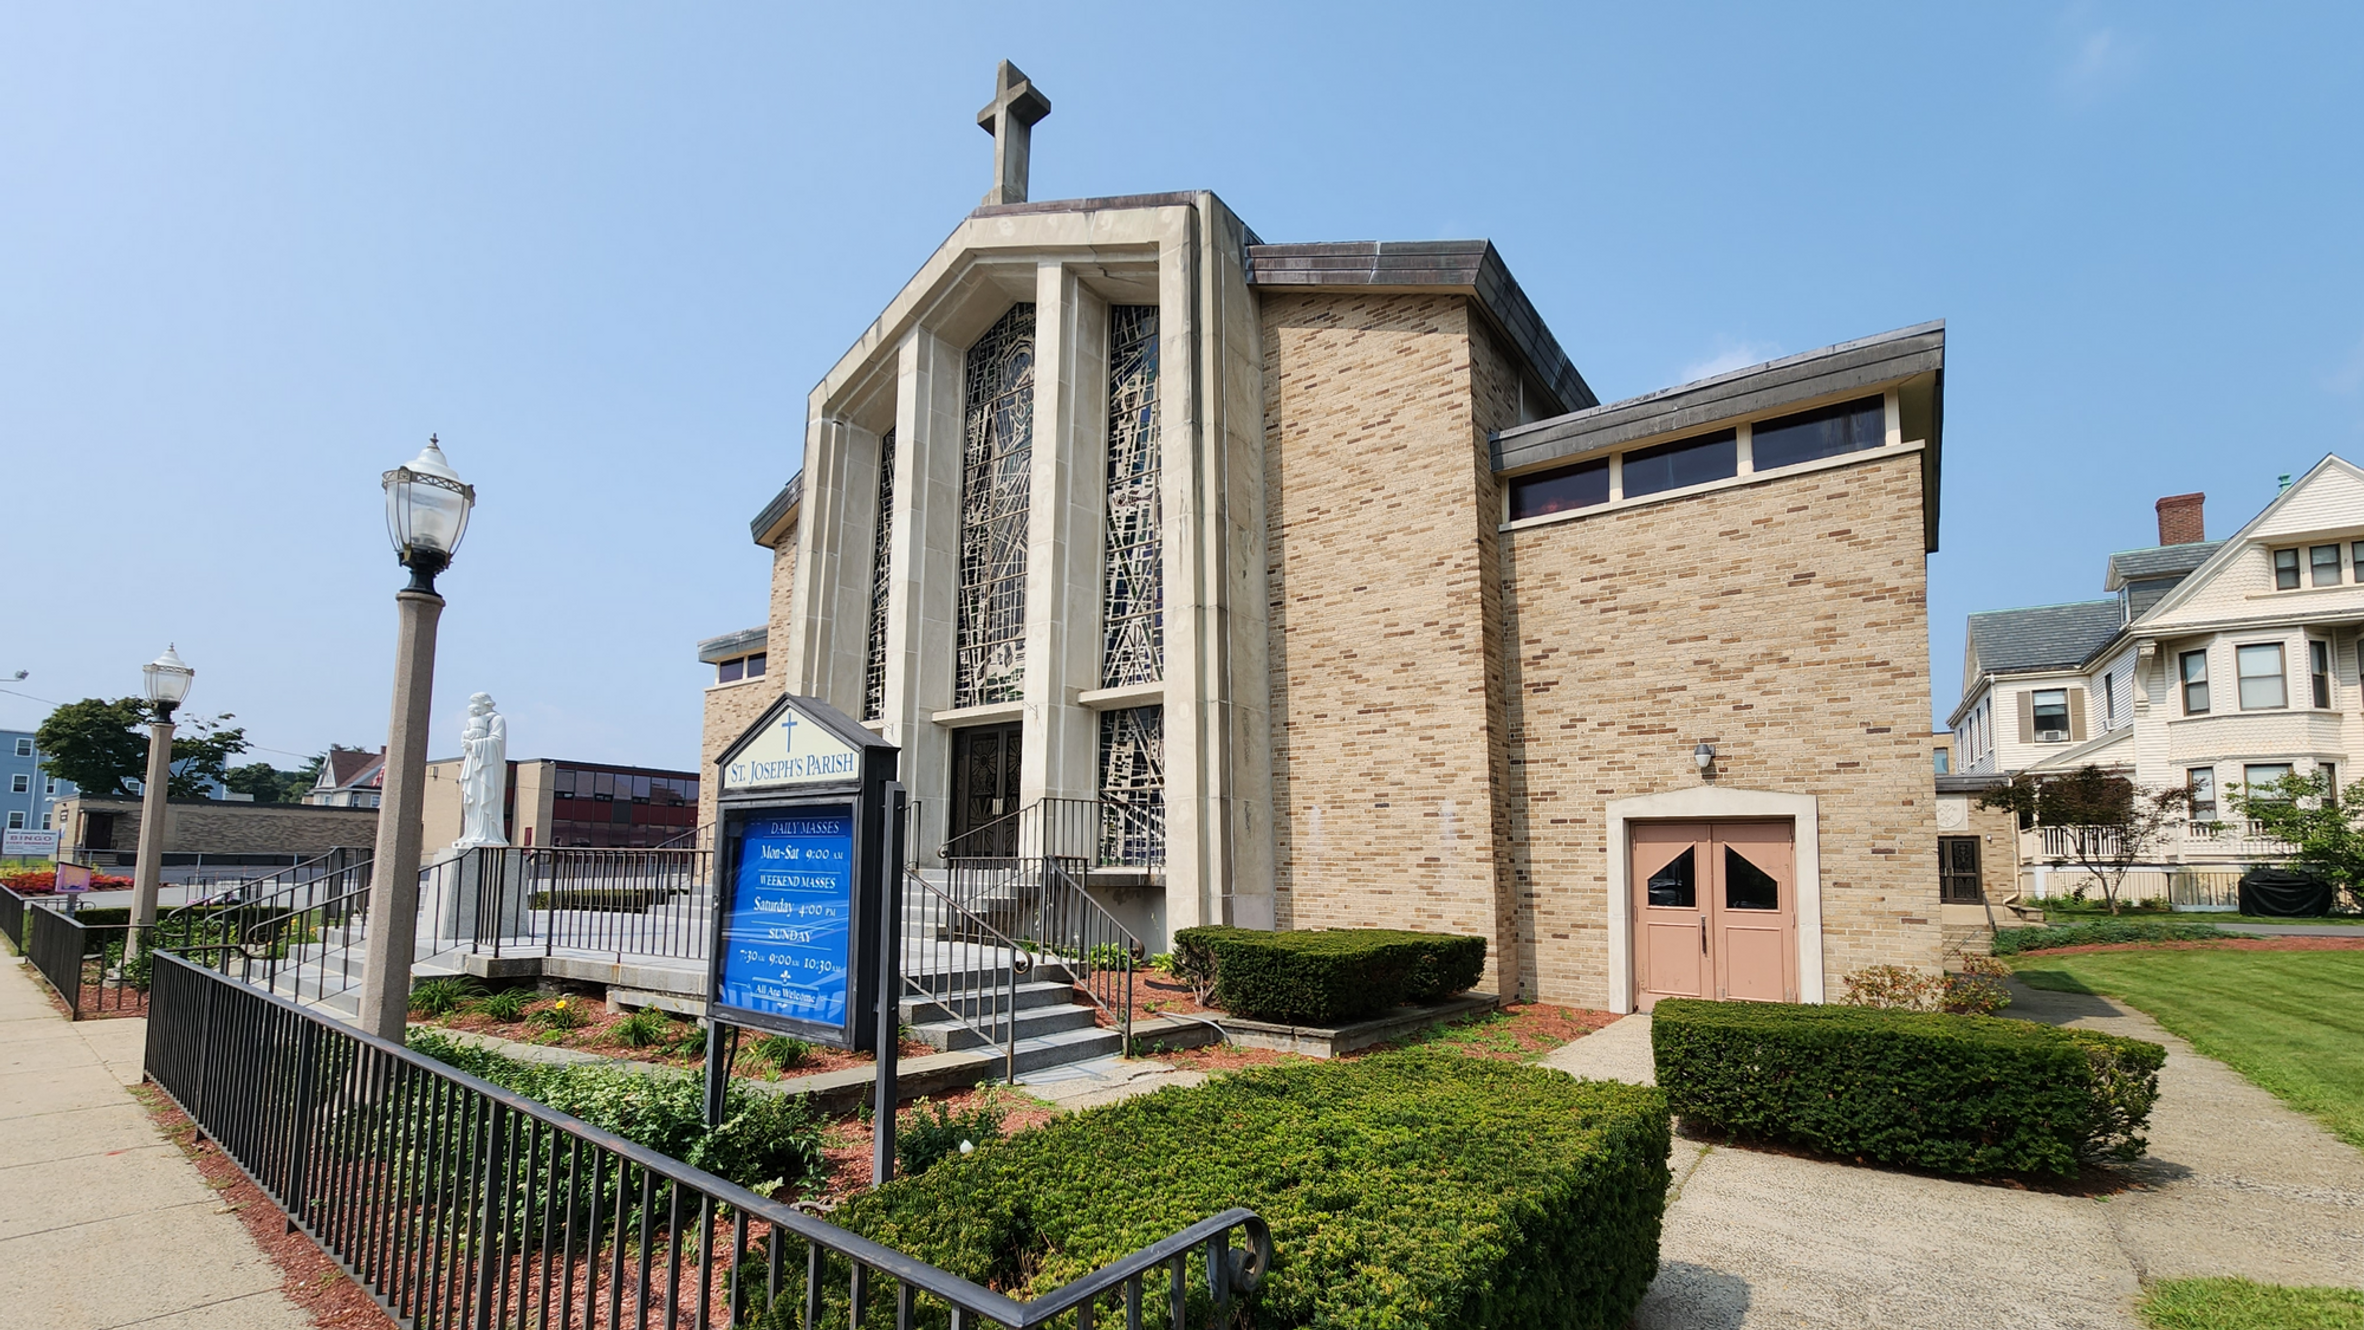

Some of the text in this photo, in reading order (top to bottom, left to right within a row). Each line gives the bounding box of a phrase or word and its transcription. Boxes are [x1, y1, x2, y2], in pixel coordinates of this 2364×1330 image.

[731, 753, 854, 785] ST. JOSEPH'S PARISH
[771, 821, 840, 834] DAILY MASSES
[805, 849, 830, 862] 9:00
[760, 874, 836, 889] WEEKEND MASSES
[753, 896, 794, 918] Saturday
[798, 904, 823, 918] 4:00
[768, 927, 813, 943] SUNDAY
[768, 953, 792, 967] 9:00
[804, 957, 832, 975] 10:30
[756, 984, 816, 1004] All Are Welcome
